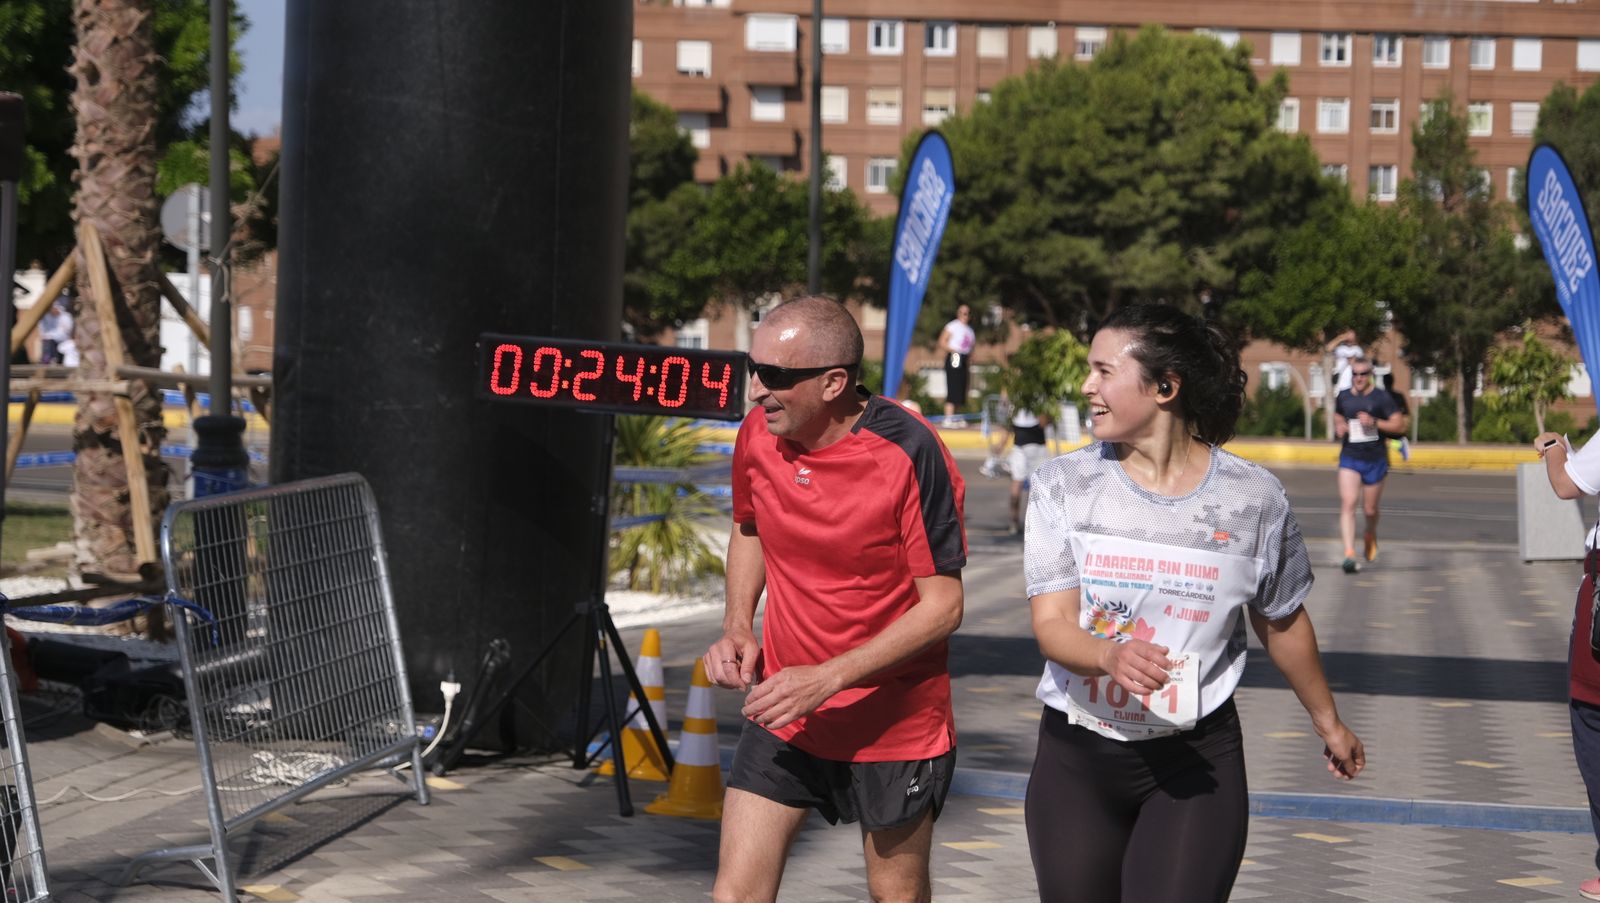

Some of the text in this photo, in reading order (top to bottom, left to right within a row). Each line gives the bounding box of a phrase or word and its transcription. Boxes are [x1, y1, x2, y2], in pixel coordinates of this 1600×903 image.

[490, 343, 731, 408] 00:24:04
[1095, 554, 1154, 572] CARRERA
[1158, 560, 1181, 575] SIN
[1185, 563, 1219, 580] HUMO
[1164, 604, 1210, 623] 4 JUNIO
